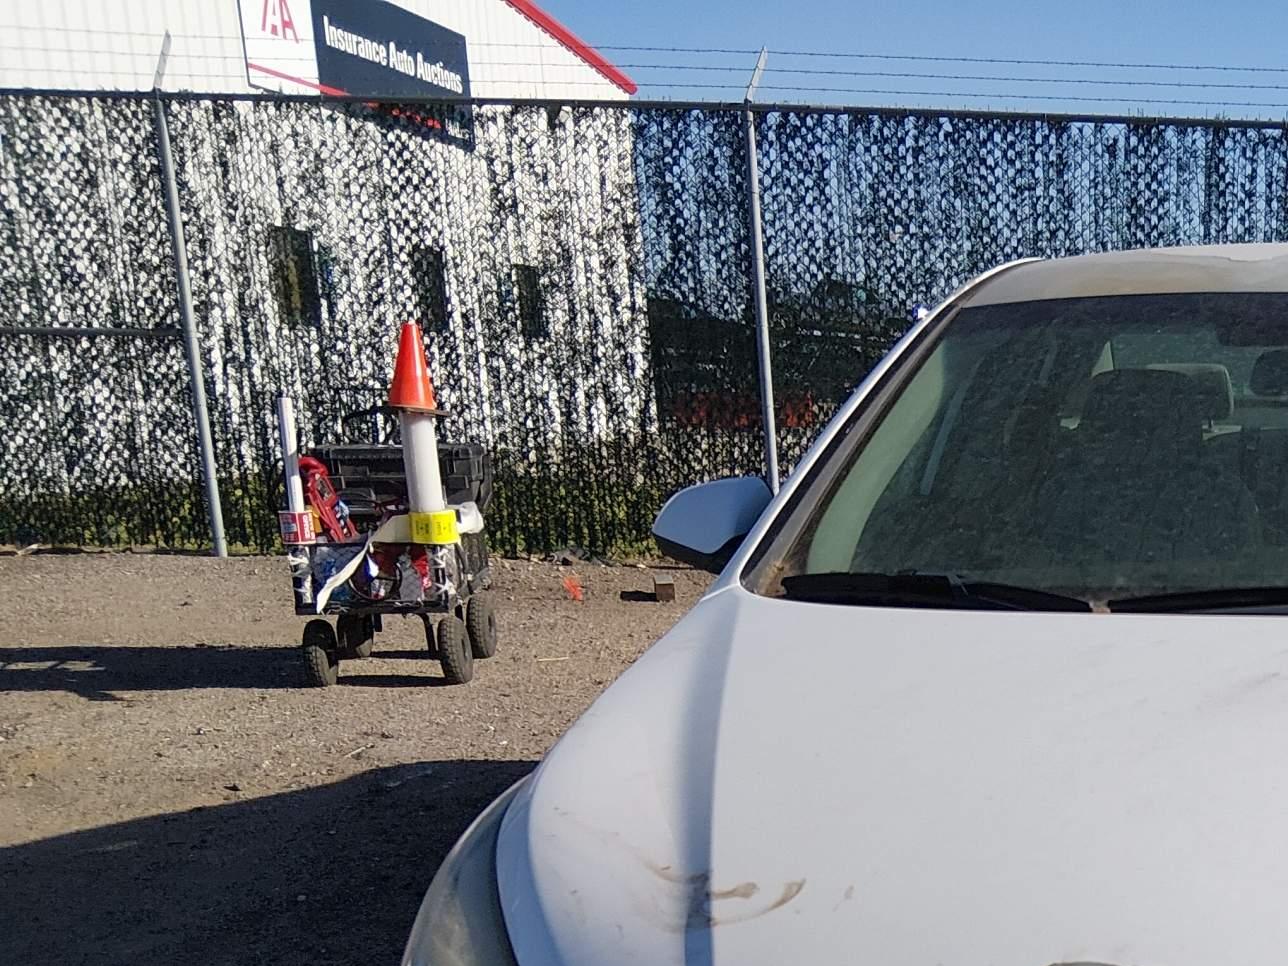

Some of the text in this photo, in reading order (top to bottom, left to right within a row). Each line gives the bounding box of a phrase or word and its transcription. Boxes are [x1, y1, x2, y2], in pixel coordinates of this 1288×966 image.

[322, 14, 463, 94] Insurance Auto Auctions
